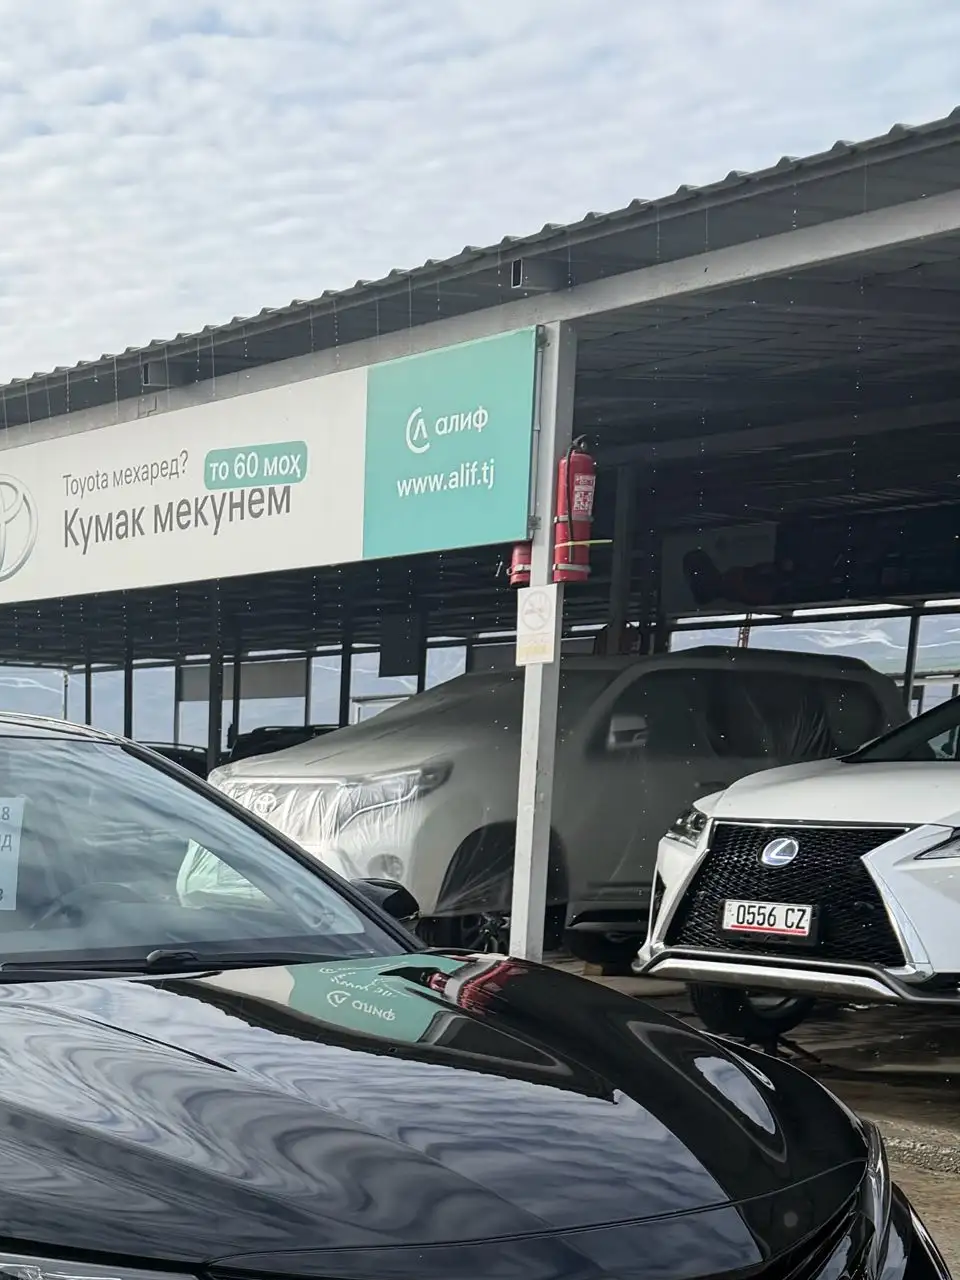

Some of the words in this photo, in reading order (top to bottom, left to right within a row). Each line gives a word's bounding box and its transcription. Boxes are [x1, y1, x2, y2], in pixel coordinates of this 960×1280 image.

[435, 405, 489, 435] алиф
[63, 470, 109, 499] Toyota
[112, 449, 189, 485] мехаред?
[209, 462, 229, 481] то
[233, 451, 259, 479] 60
[397, 458, 495, 497] www.alif.tj
[64, 505, 145, 555] Кумак
[153, 485, 291, 535] мекунем
[736, 904, 777, 928] 0556
[784, 907, 807, 930] CZ
